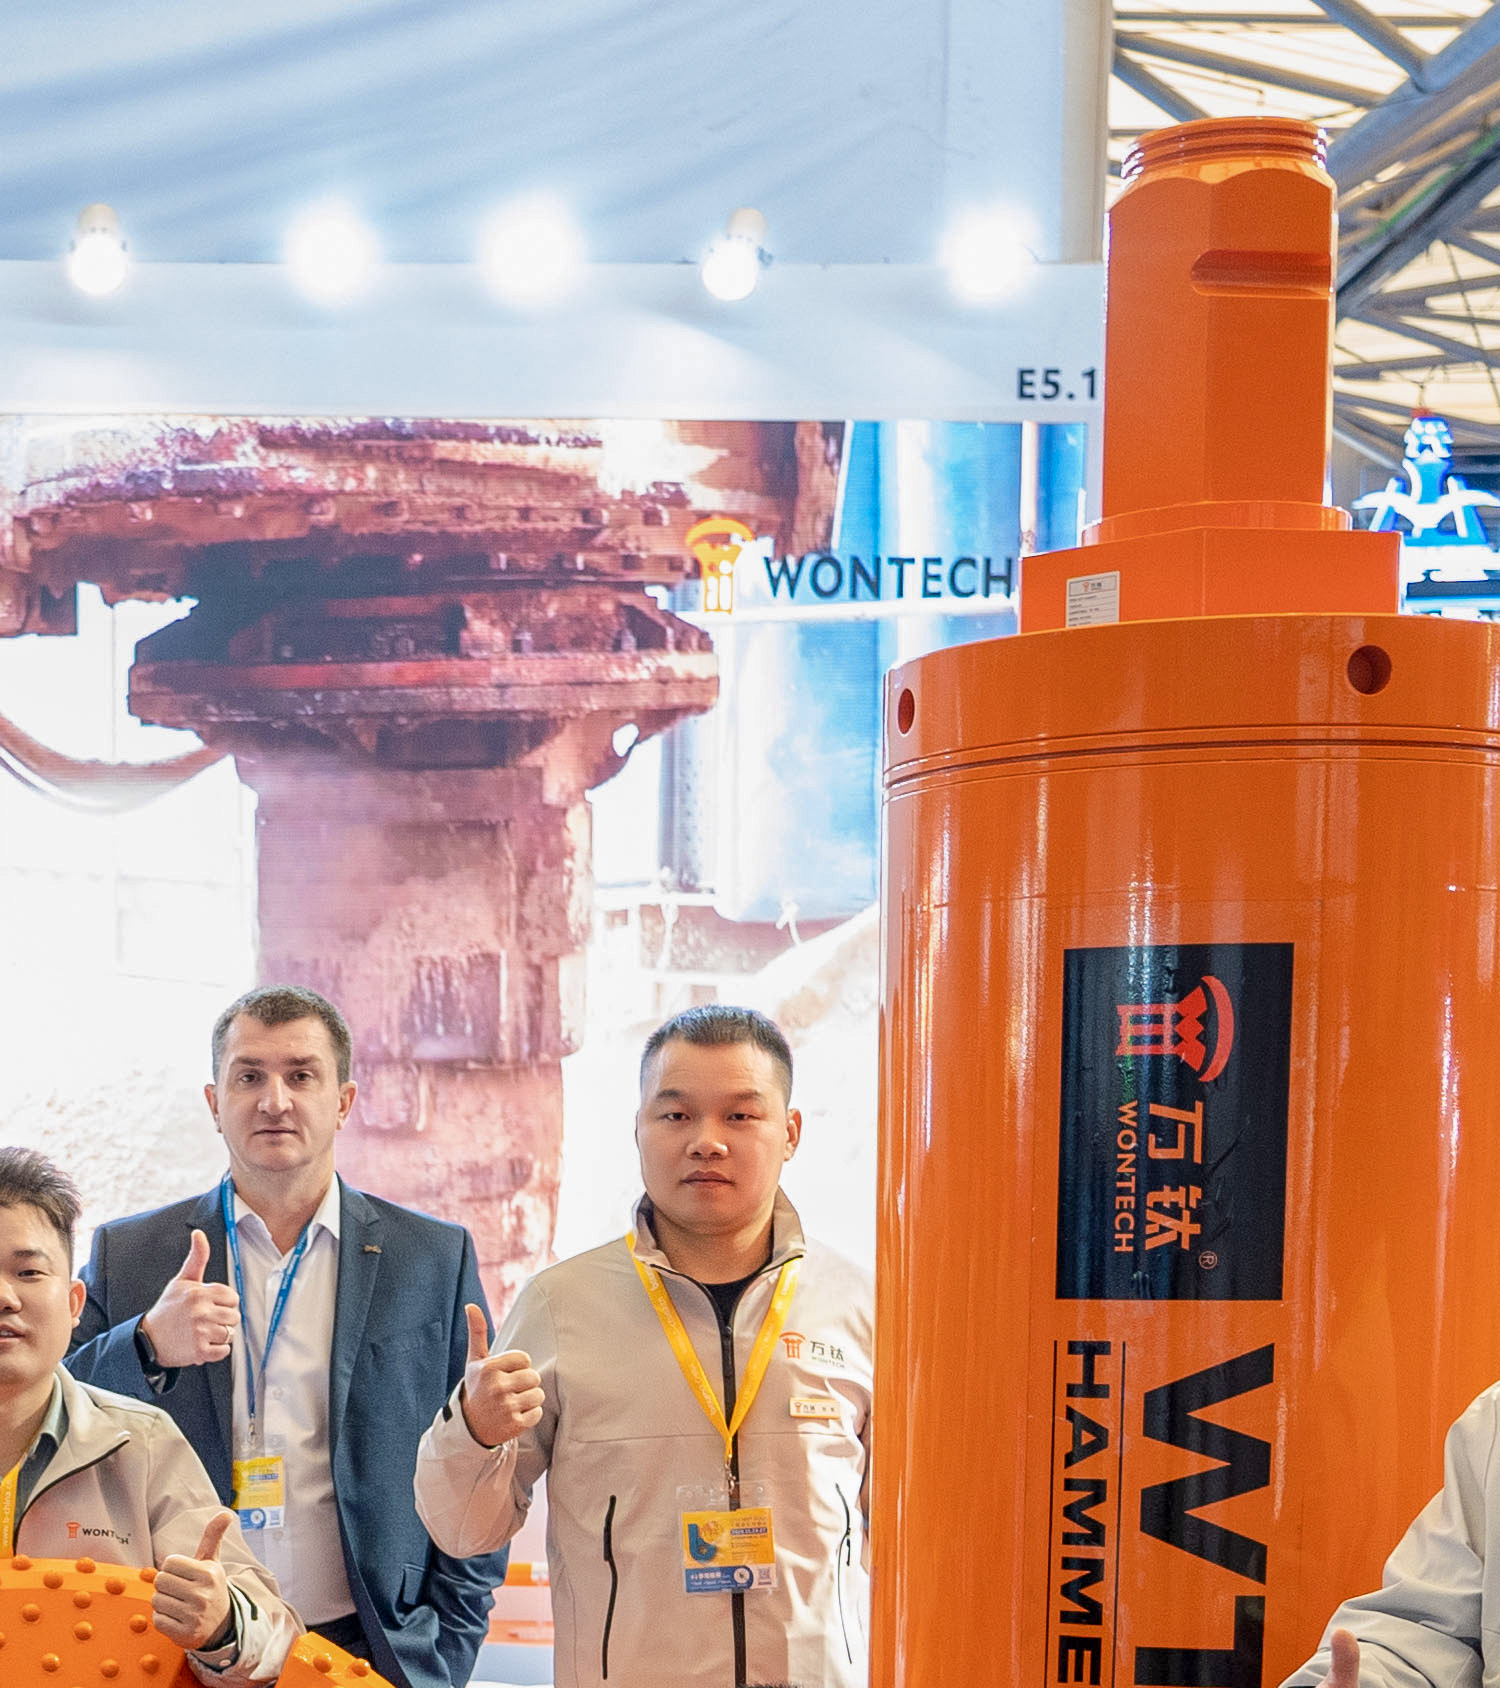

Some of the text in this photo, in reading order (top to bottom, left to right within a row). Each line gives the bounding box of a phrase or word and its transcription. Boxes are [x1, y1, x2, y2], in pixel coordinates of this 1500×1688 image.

[764, 556, 1014, 600] WONTECH
[1114, 1100, 1139, 1254] WONTECH
[1145, 1100, 1204, 1253] 万钛
